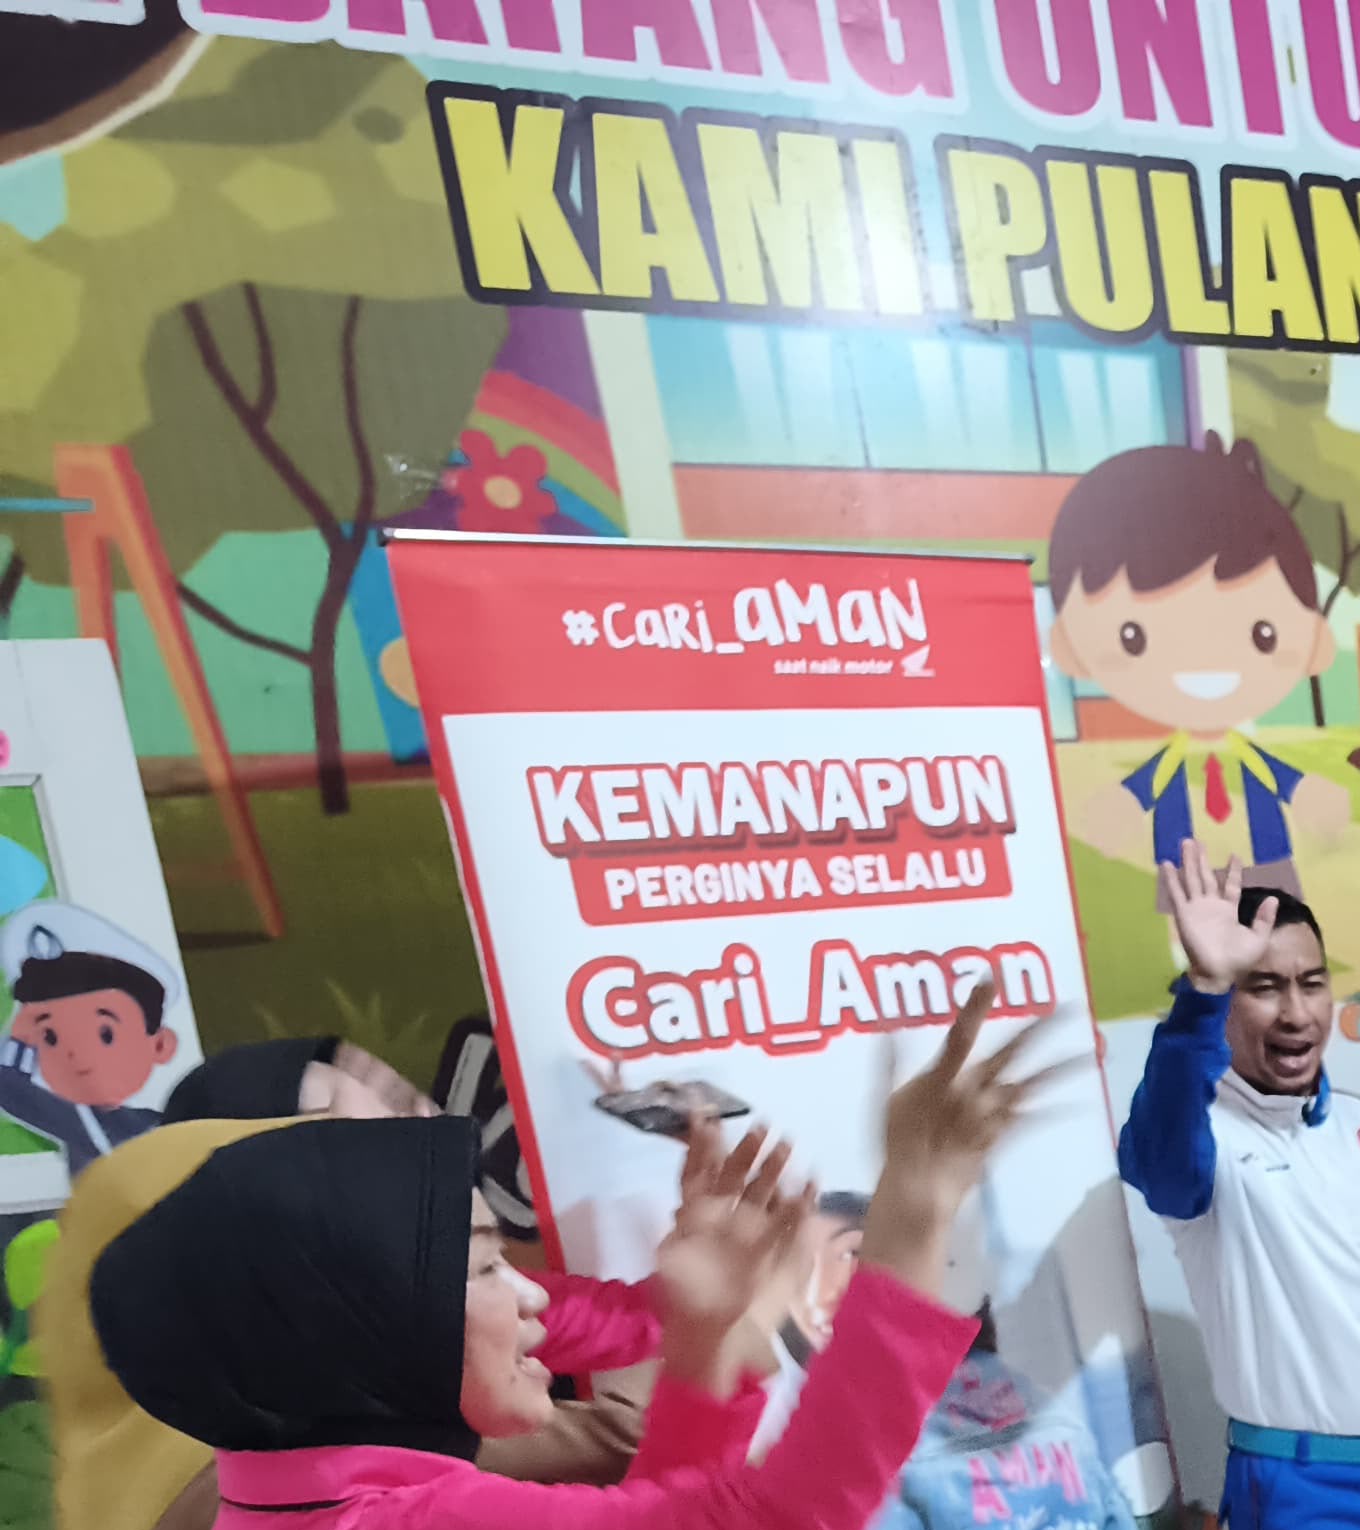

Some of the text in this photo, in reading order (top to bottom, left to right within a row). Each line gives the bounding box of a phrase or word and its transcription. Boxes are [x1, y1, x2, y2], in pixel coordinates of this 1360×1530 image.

[436, 88, 930, 320] KAMI
[529, 756, 1011, 851] KEMANAPUN
[603, 847, 987, 910] PERGINYA SELALU
